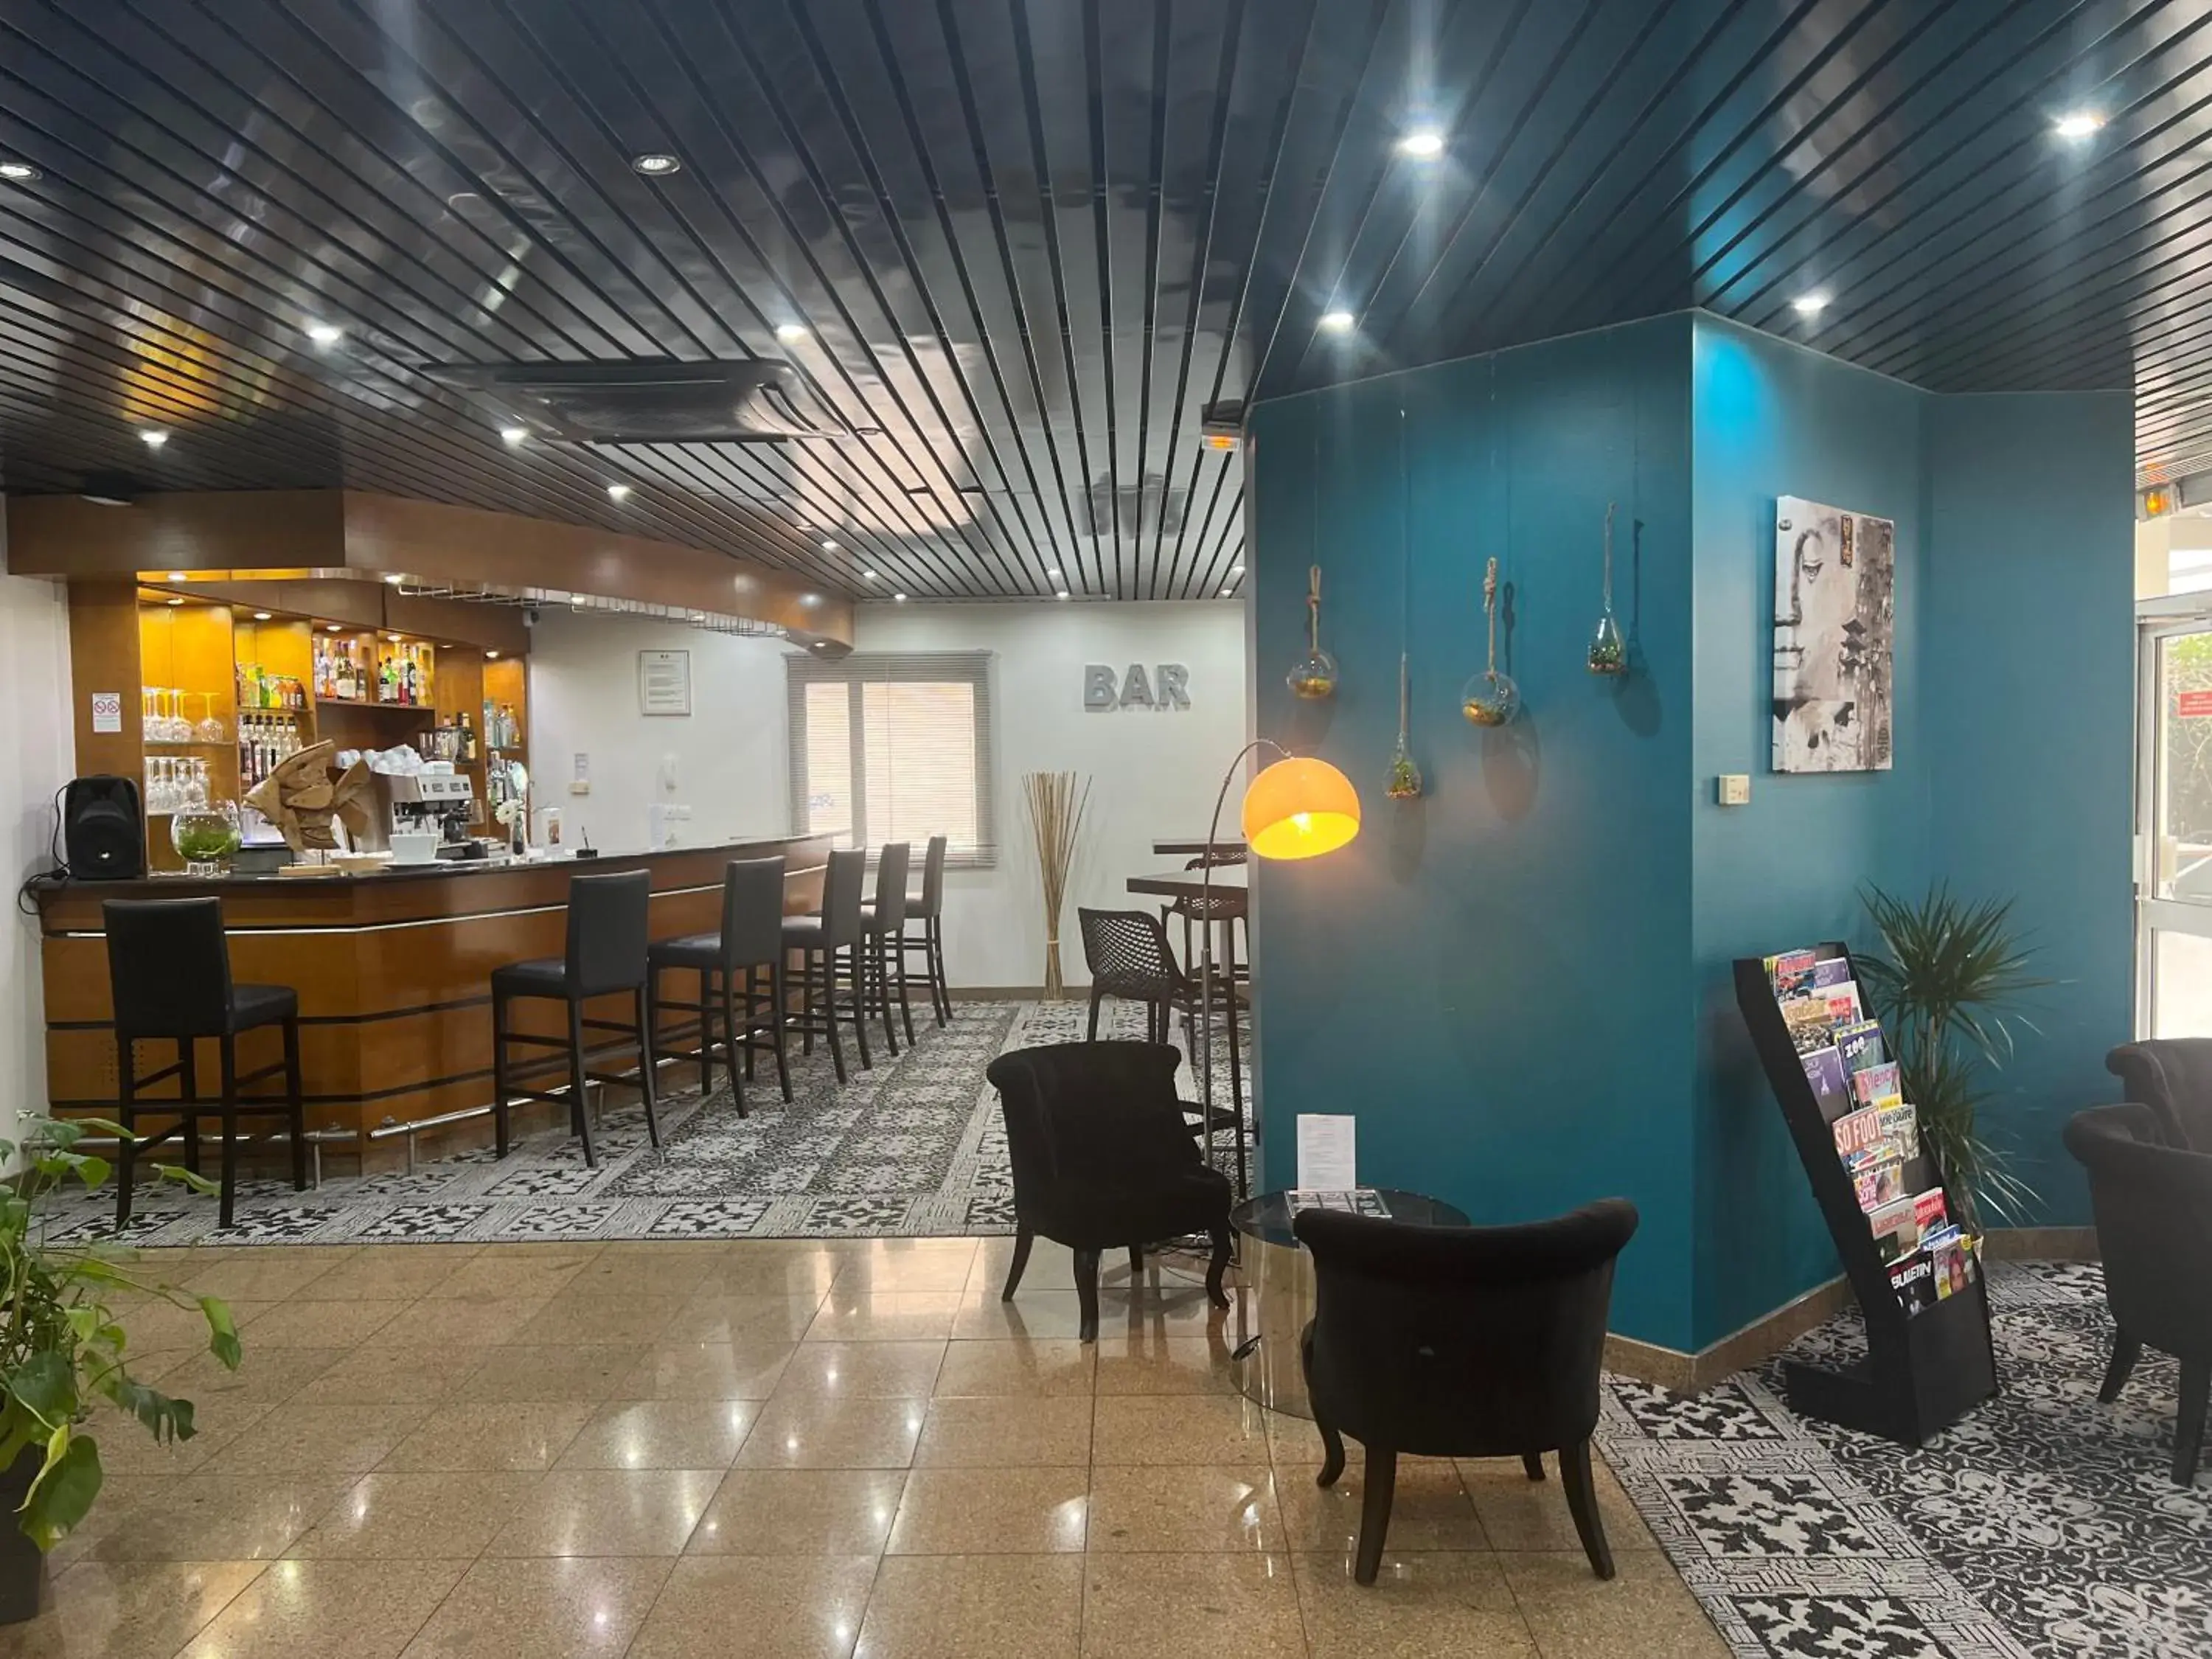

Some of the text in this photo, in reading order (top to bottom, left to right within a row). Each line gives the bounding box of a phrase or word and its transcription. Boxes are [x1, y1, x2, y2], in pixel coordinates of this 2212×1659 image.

[1084, 663, 1191, 712] BAR
[1834, 1110, 1881, 1153] SO FOOT
